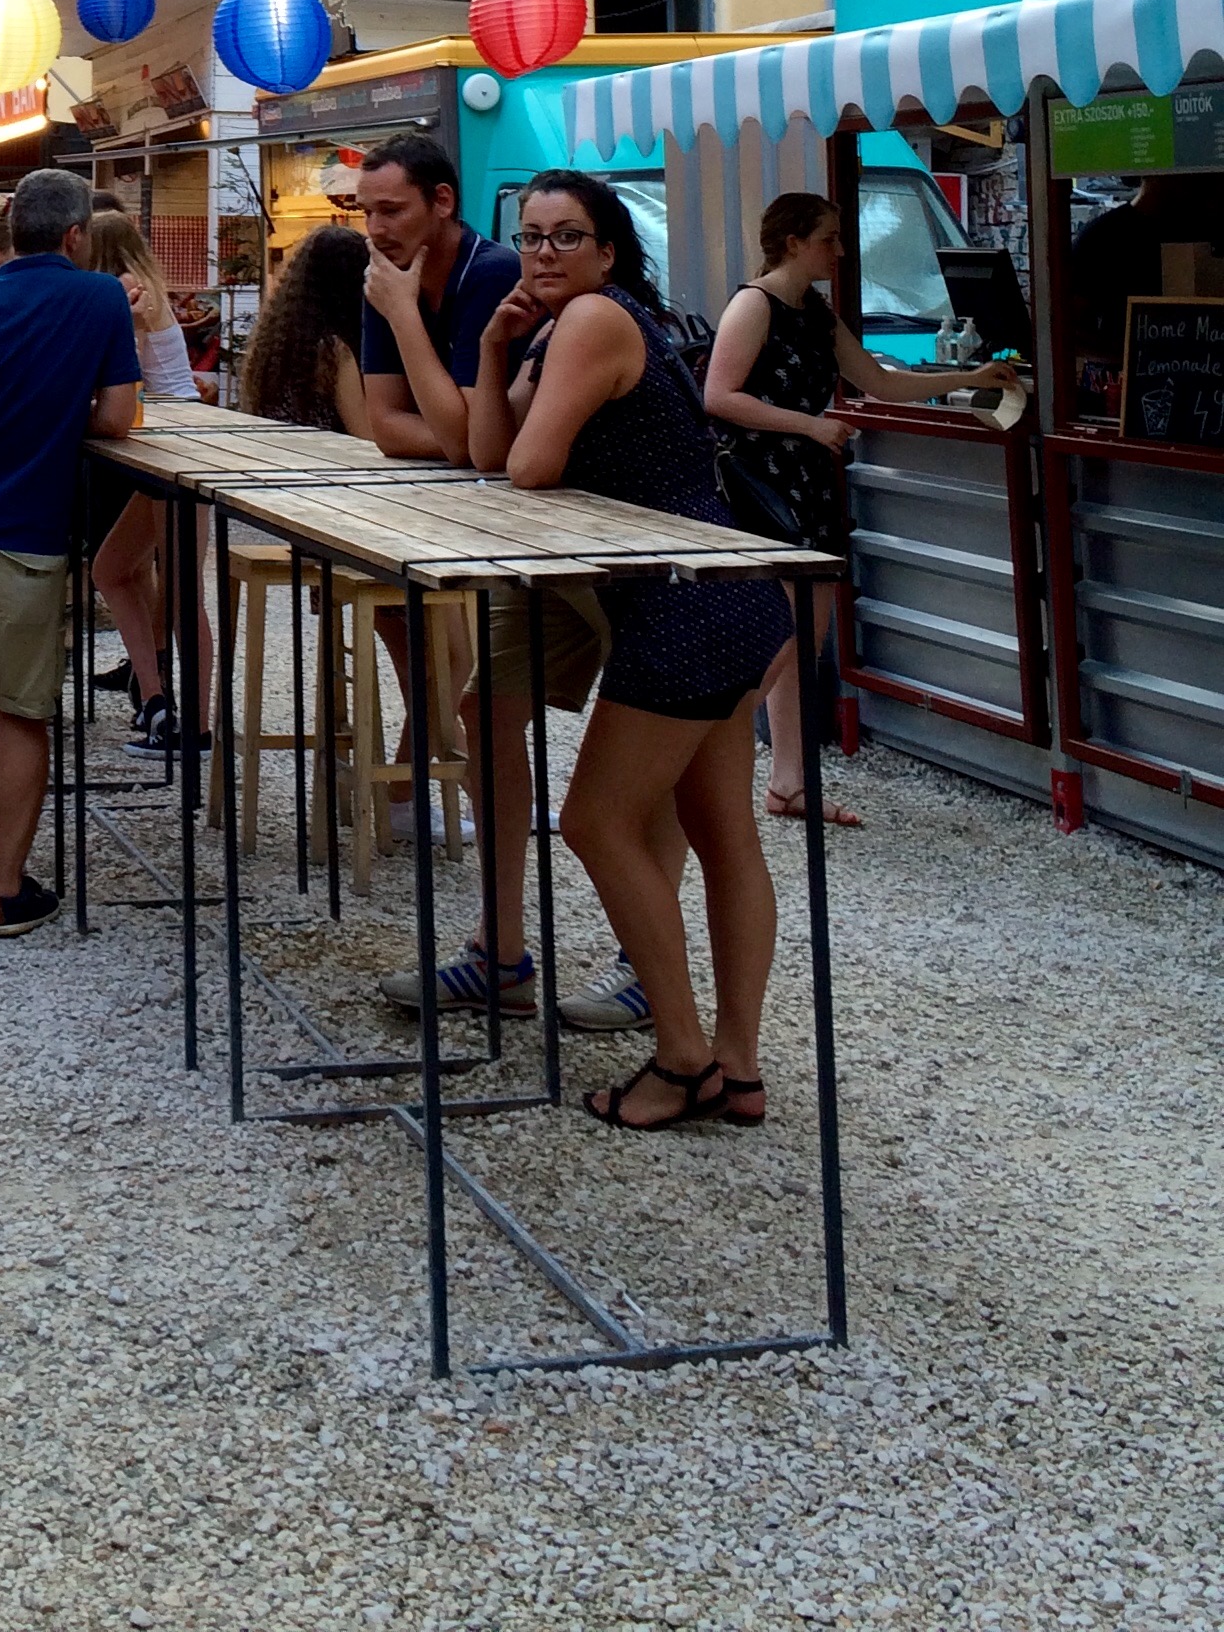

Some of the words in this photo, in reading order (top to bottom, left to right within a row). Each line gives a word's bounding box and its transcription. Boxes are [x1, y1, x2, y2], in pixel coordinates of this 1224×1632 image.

[1054, 108, 1084, 126] EXTRA
[1136, 314, 1186, 341] Home
[1135, 350, 1224, 377] Lemonade
